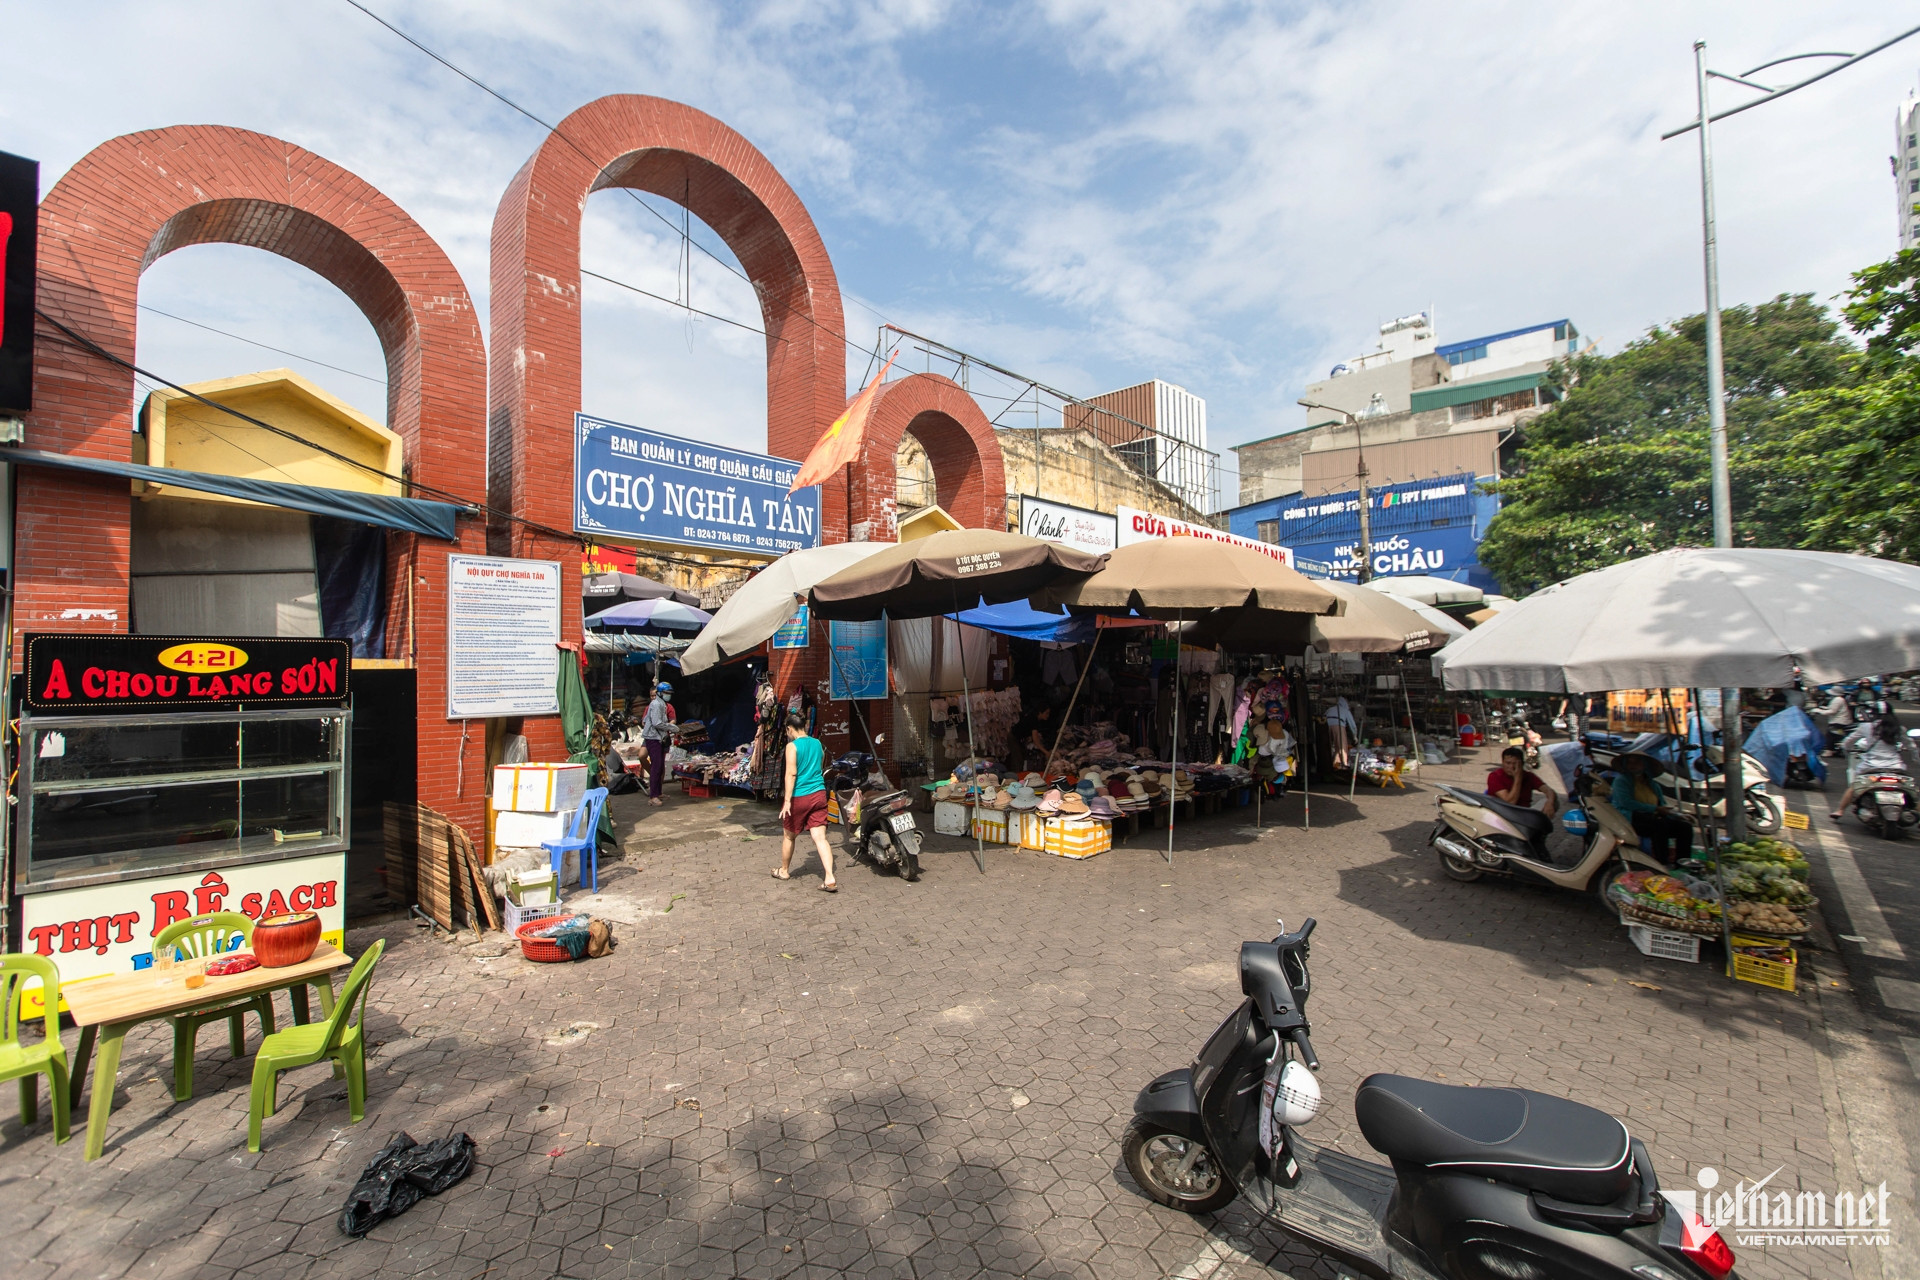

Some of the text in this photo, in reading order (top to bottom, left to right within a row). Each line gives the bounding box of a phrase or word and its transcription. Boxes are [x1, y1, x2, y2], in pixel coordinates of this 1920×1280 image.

[611, 435, 638, 455] BAN
[642, 441, 674, 462] QUẢN
[678, 448, 691, 466] LÝ
[694, 454, 718, 474] CHỢ
[720, 460, 750, 480] QUẬN
[586, 468, 814, 536] CHỢ NGHĨA TÂN
[1402, 484, 1466, 504] FPT PHARMA
[1284, 508, 1306, 520] CÔNG
[1308, 506, 1319, 516] TY
[684, 526, 696, 537] ĐT:
[697, 528, 716, 540] 0243
[718, 532, 730, 542] 764
[732, 533, 750, 544] 6878
[756, 536, 773, 546] 0243
[775, 539, 802, 550] 7562782
[1133, 514, 1168, 538] CỬA
[1368, 535, 1410, 553] HUỐC
[467, 567, 479, 578] NỘI
[496, 570, 510, 579] CHỢ
[1374, 548, 1444, 574] CHÂU
[174, 650, 236, 667] 4:21
[42, 657, 338, 700] A CHOU LẠNG SƠN
[28, 911, 140, 957] THỊT
[151, 872, 230, 938] BÊ
